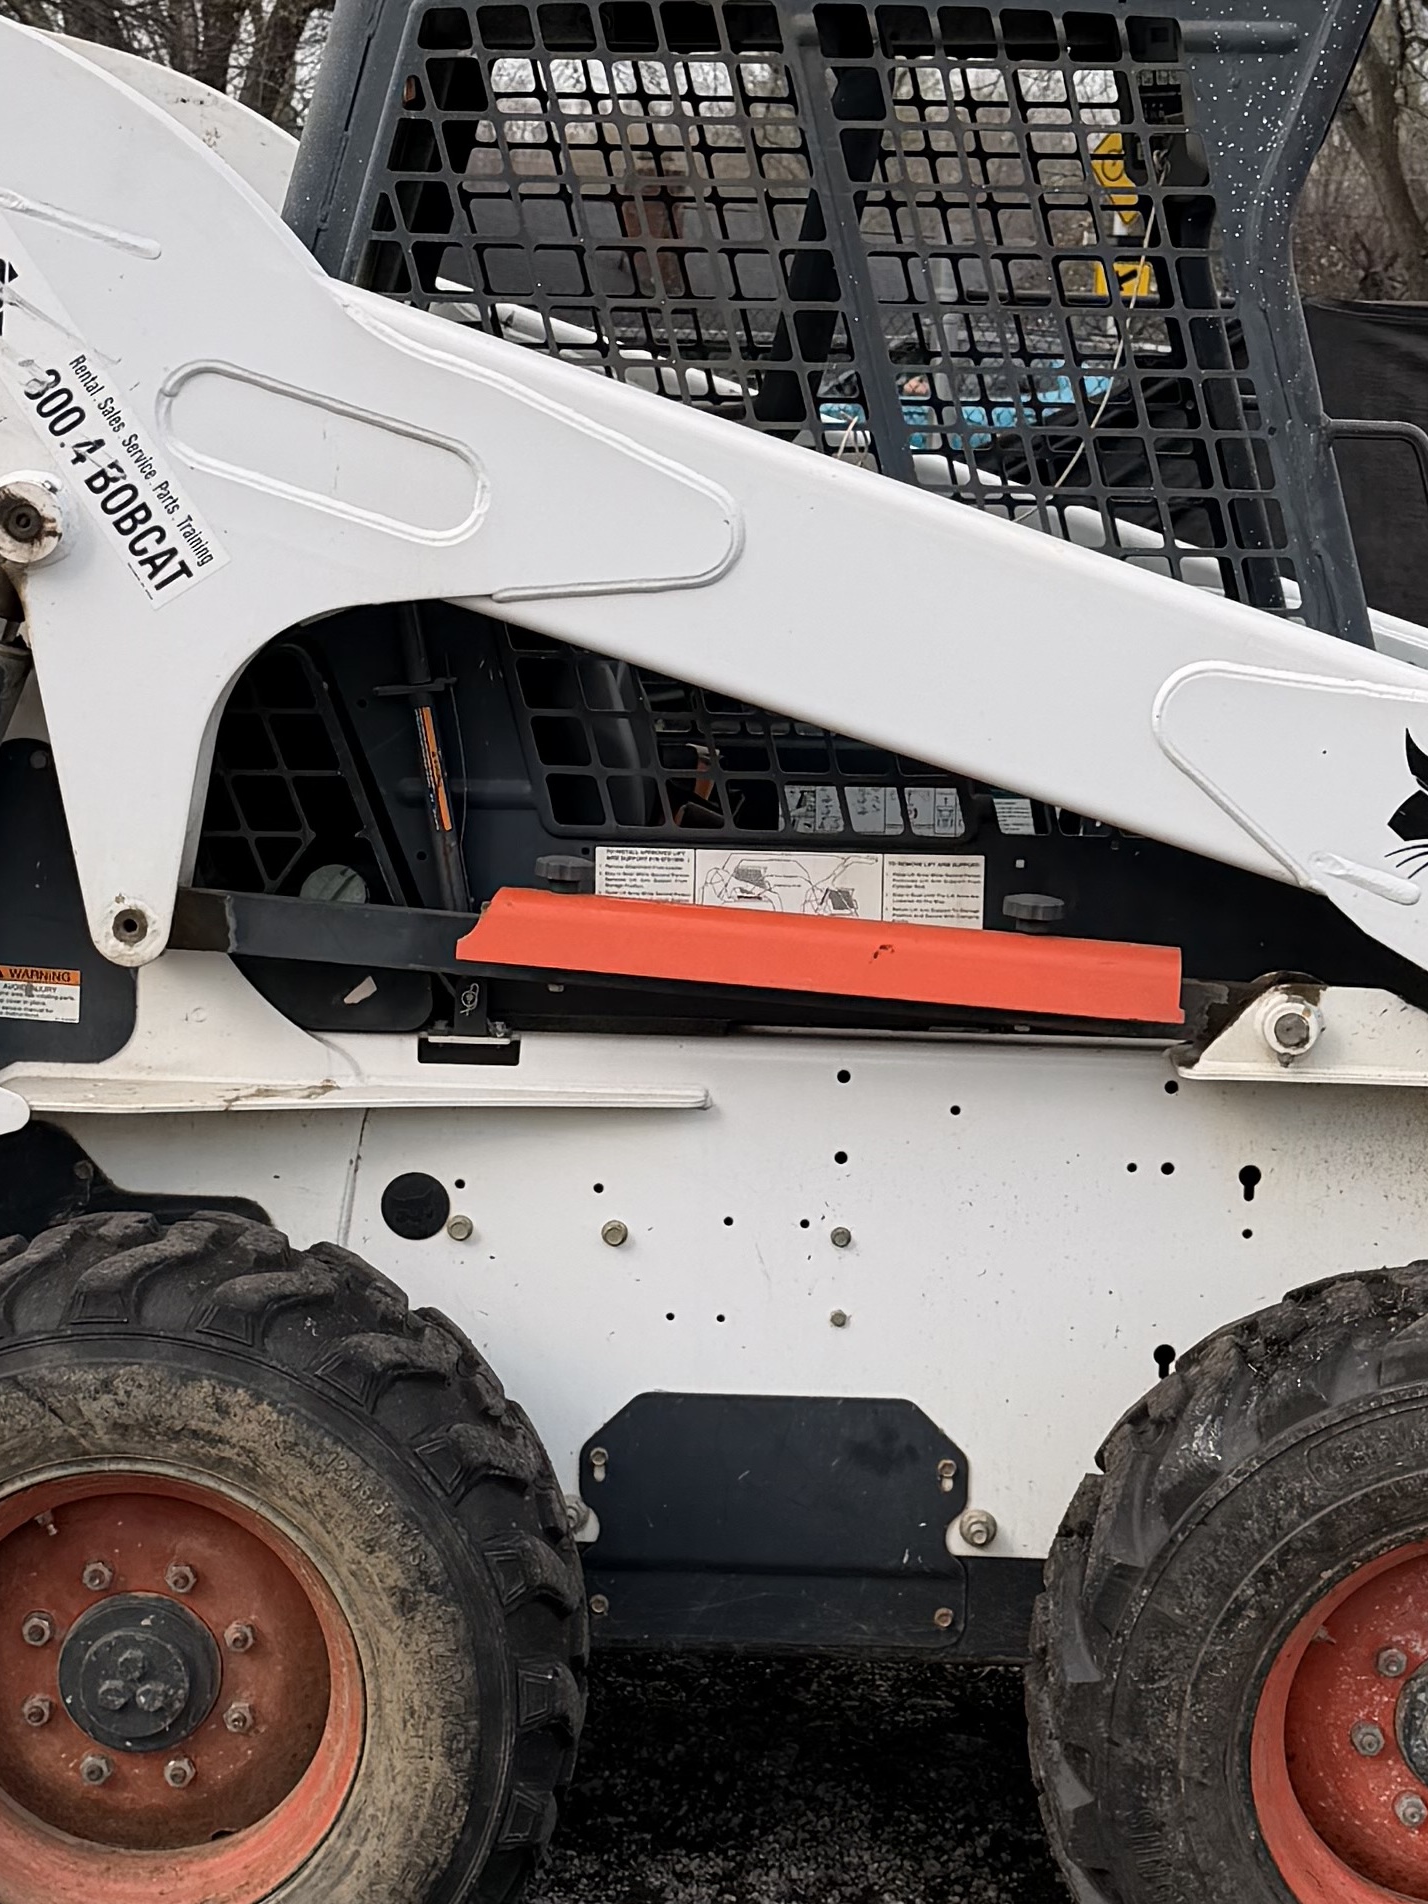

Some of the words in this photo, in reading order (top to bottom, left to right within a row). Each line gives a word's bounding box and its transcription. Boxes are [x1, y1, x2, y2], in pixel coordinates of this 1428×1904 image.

[69, 354, 105, 397] Rental
[98, 397, 125, 432] Sales
[122, 433, 157, 480] Service
[152, 480, 180, 515] Parts
[176, 514, 214, 567] Training
[84, 460, 193, 591] BOBCAT
[9, 968, 71, 983] WARNING
